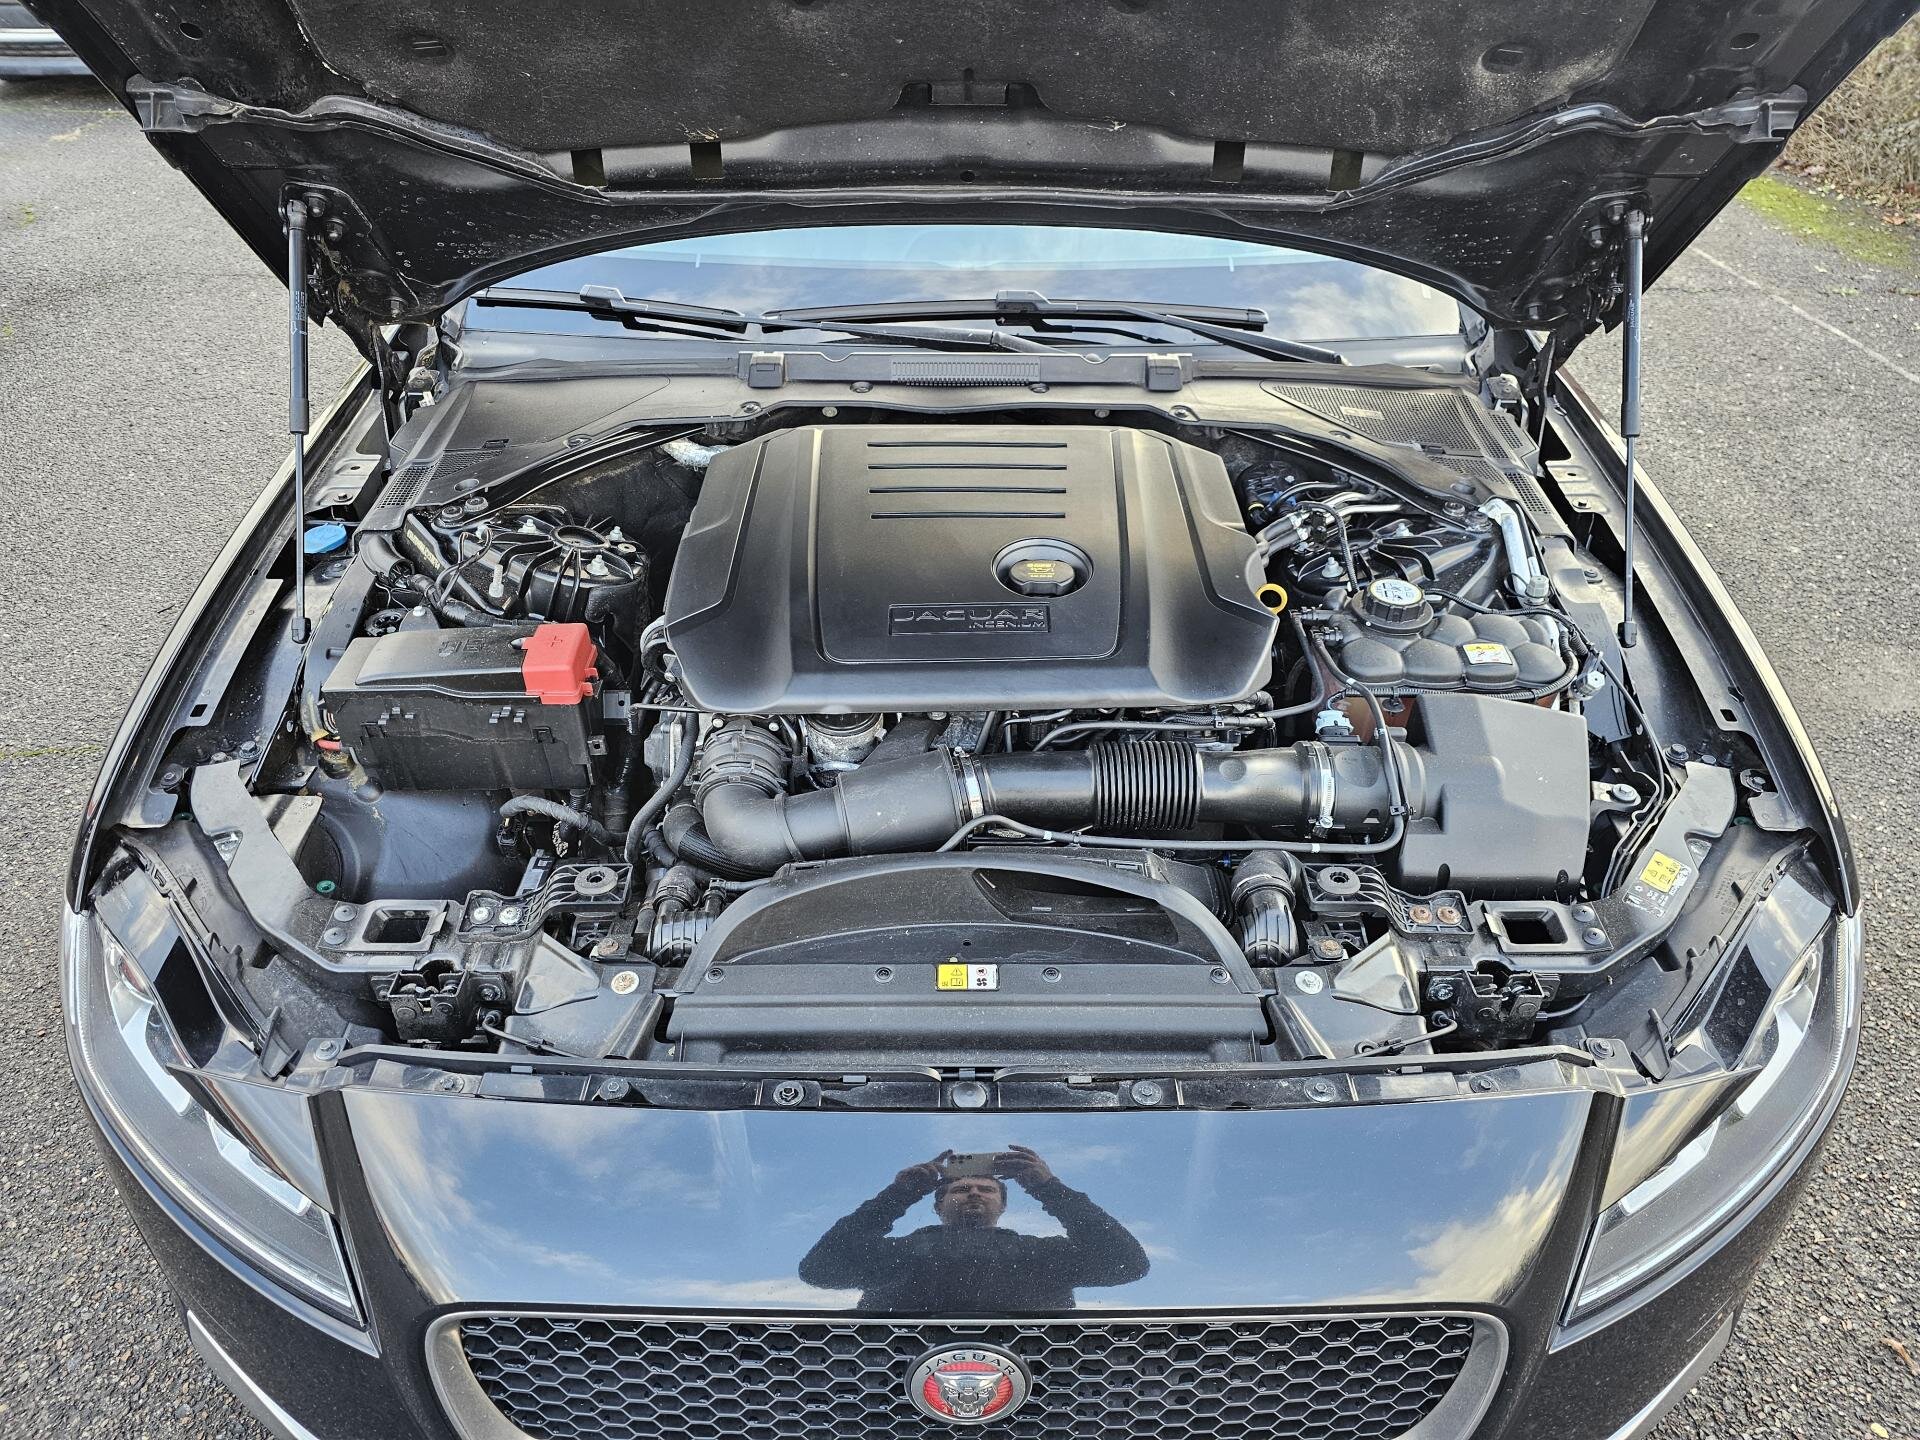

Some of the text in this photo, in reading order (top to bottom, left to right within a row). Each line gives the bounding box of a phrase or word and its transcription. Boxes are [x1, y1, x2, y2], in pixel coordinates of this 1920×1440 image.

[894, 608, 1045, 622] JAGUAR
[968, 620, 1046, 629] INGENIUM
[924, 1353, 1016, 1376] JAGUAR
